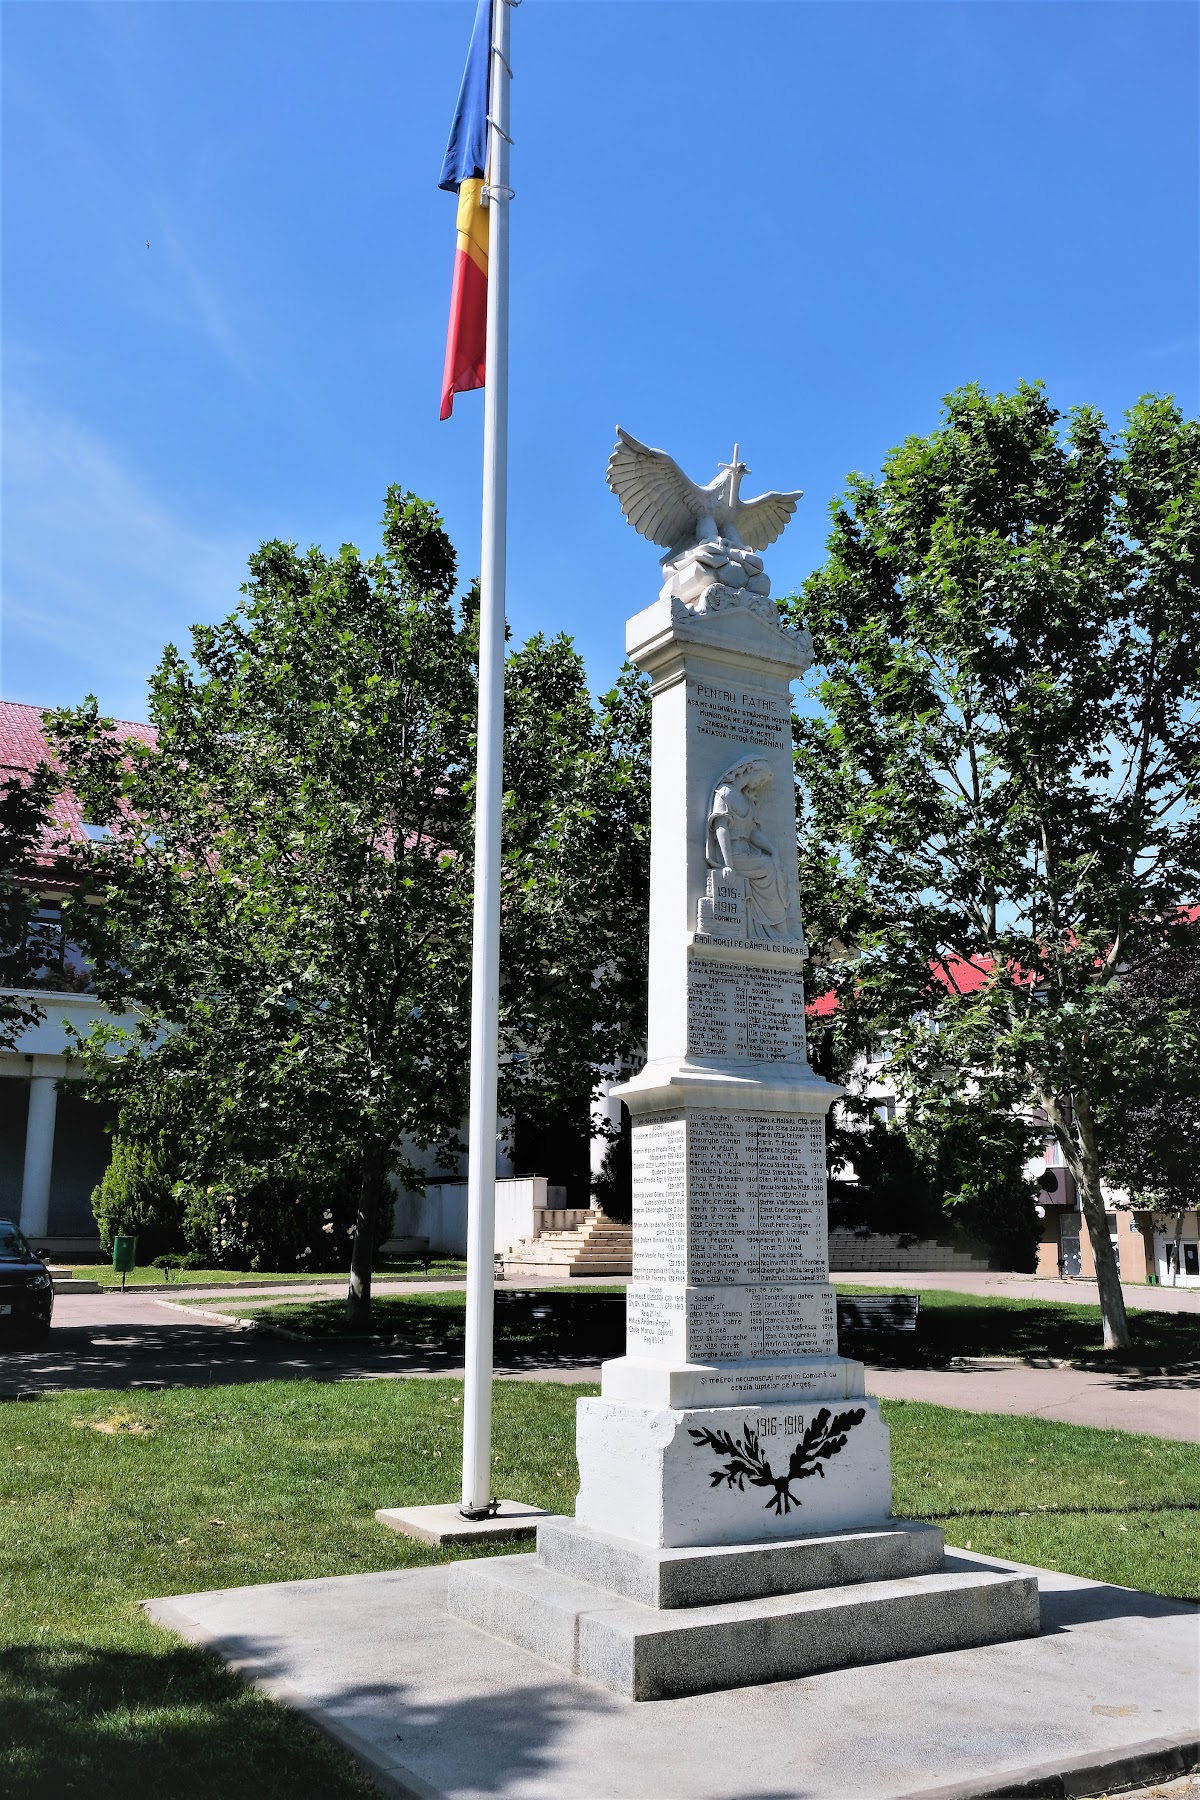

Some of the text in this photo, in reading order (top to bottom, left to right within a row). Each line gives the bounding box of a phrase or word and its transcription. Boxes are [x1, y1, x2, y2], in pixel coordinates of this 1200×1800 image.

[697, 684, 736, 703] PENTRU
[714, 914, 741, 924] CORNETU
[734, 940, 743, 948] PE
[772, 945, 781, 953] DE
[782, 945, 807, 956] ONOARE
[755, 1382, 779, 1391] luptelor
[781, 1382, 790, 1390] pe
[757, 1415, 804, 1437] 1916-1918
